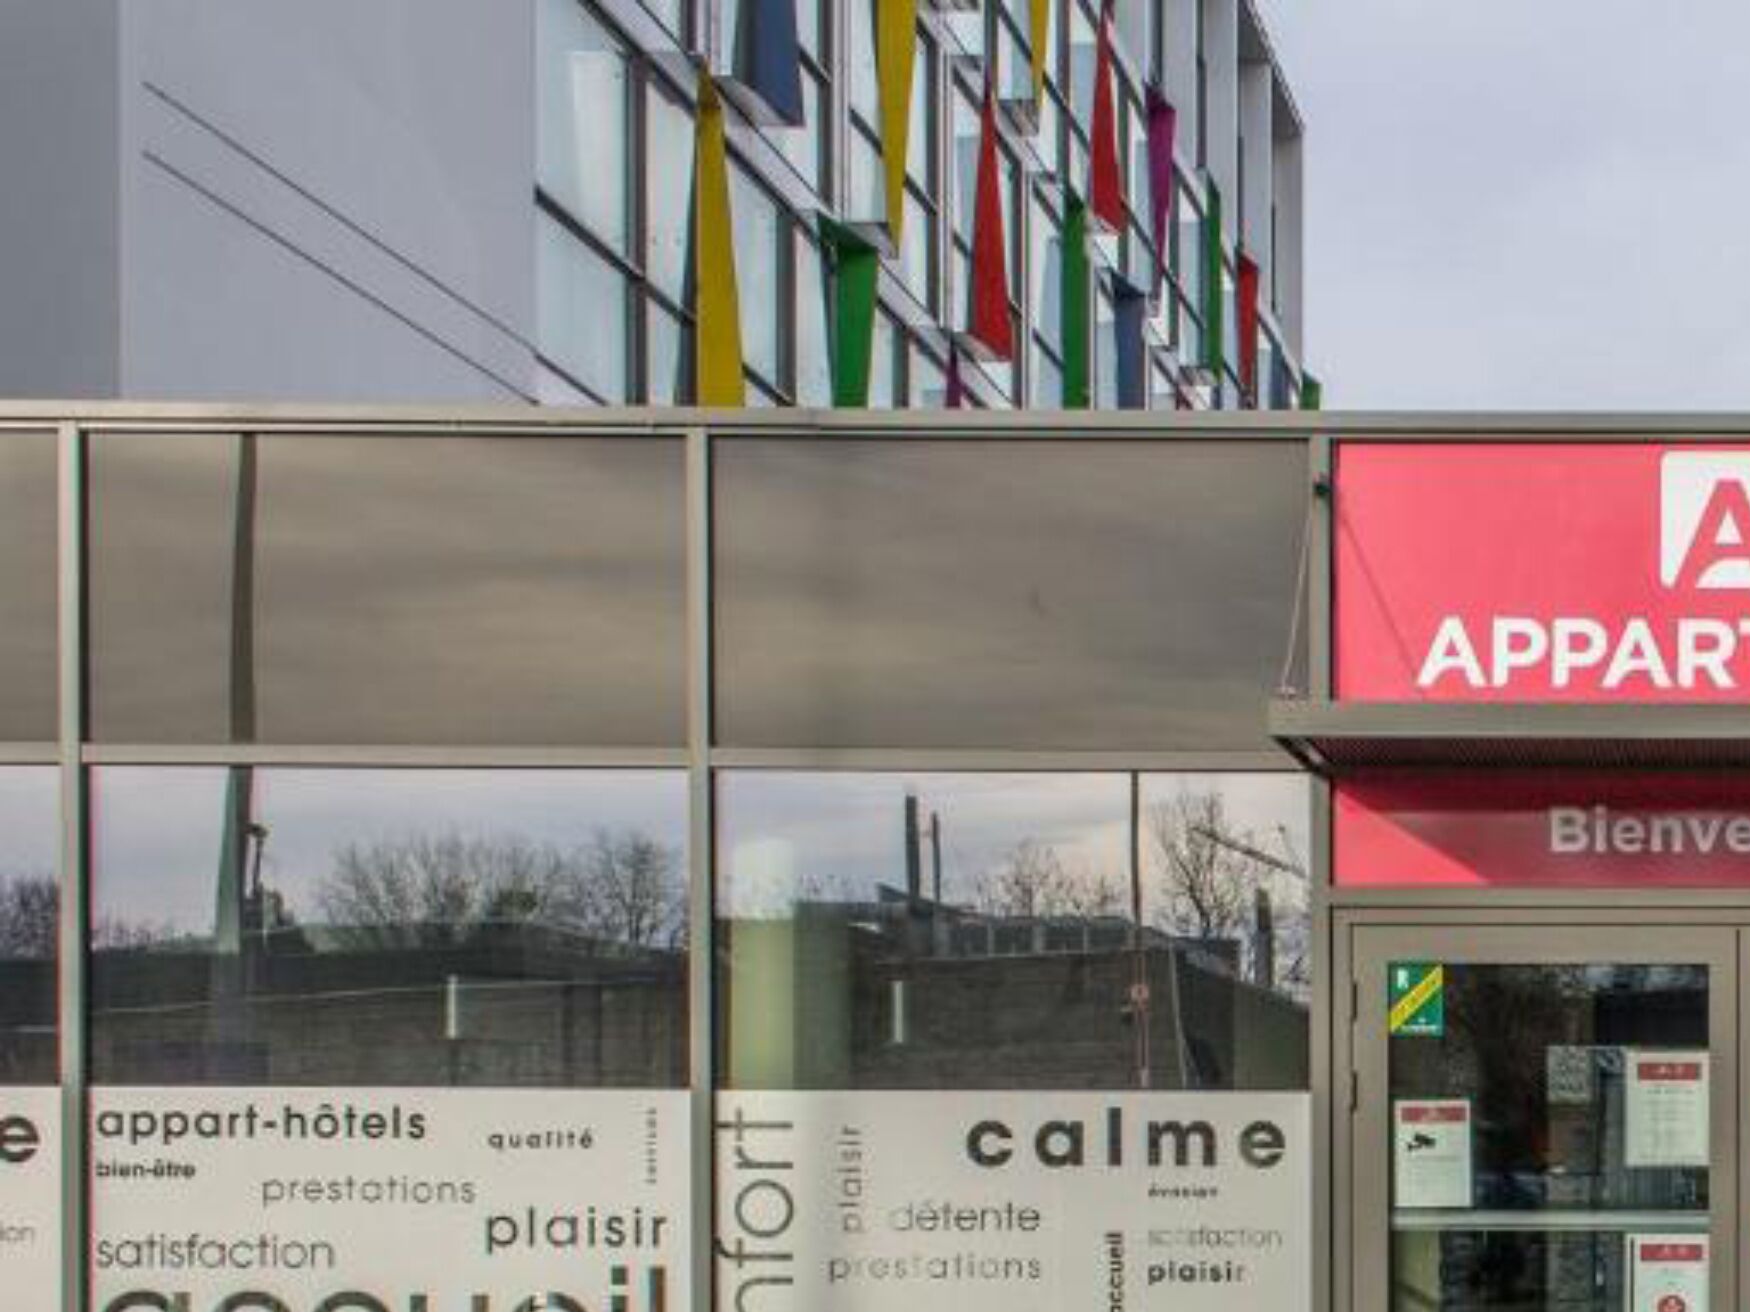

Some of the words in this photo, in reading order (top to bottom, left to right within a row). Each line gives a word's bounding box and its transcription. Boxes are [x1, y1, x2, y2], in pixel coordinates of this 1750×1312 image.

[97, 1104, 426, 1144] appart-hôtels
[488, 1129, 594, 1150] qualité
[966, 1107, 1286, 1168] calme
[262, 1177, 476, 1207] prestations
[837, 1125, 862, 1234] plaisir
[486, 1206, 667, 1254] plaisir
[891, 1201, 1041, 1232] détente
[96, 1234, 335, 1269] satisfaction
[829, 1254, 1041, 1284] prestations
[1147, 1261, 1247, 1285] plaisir
